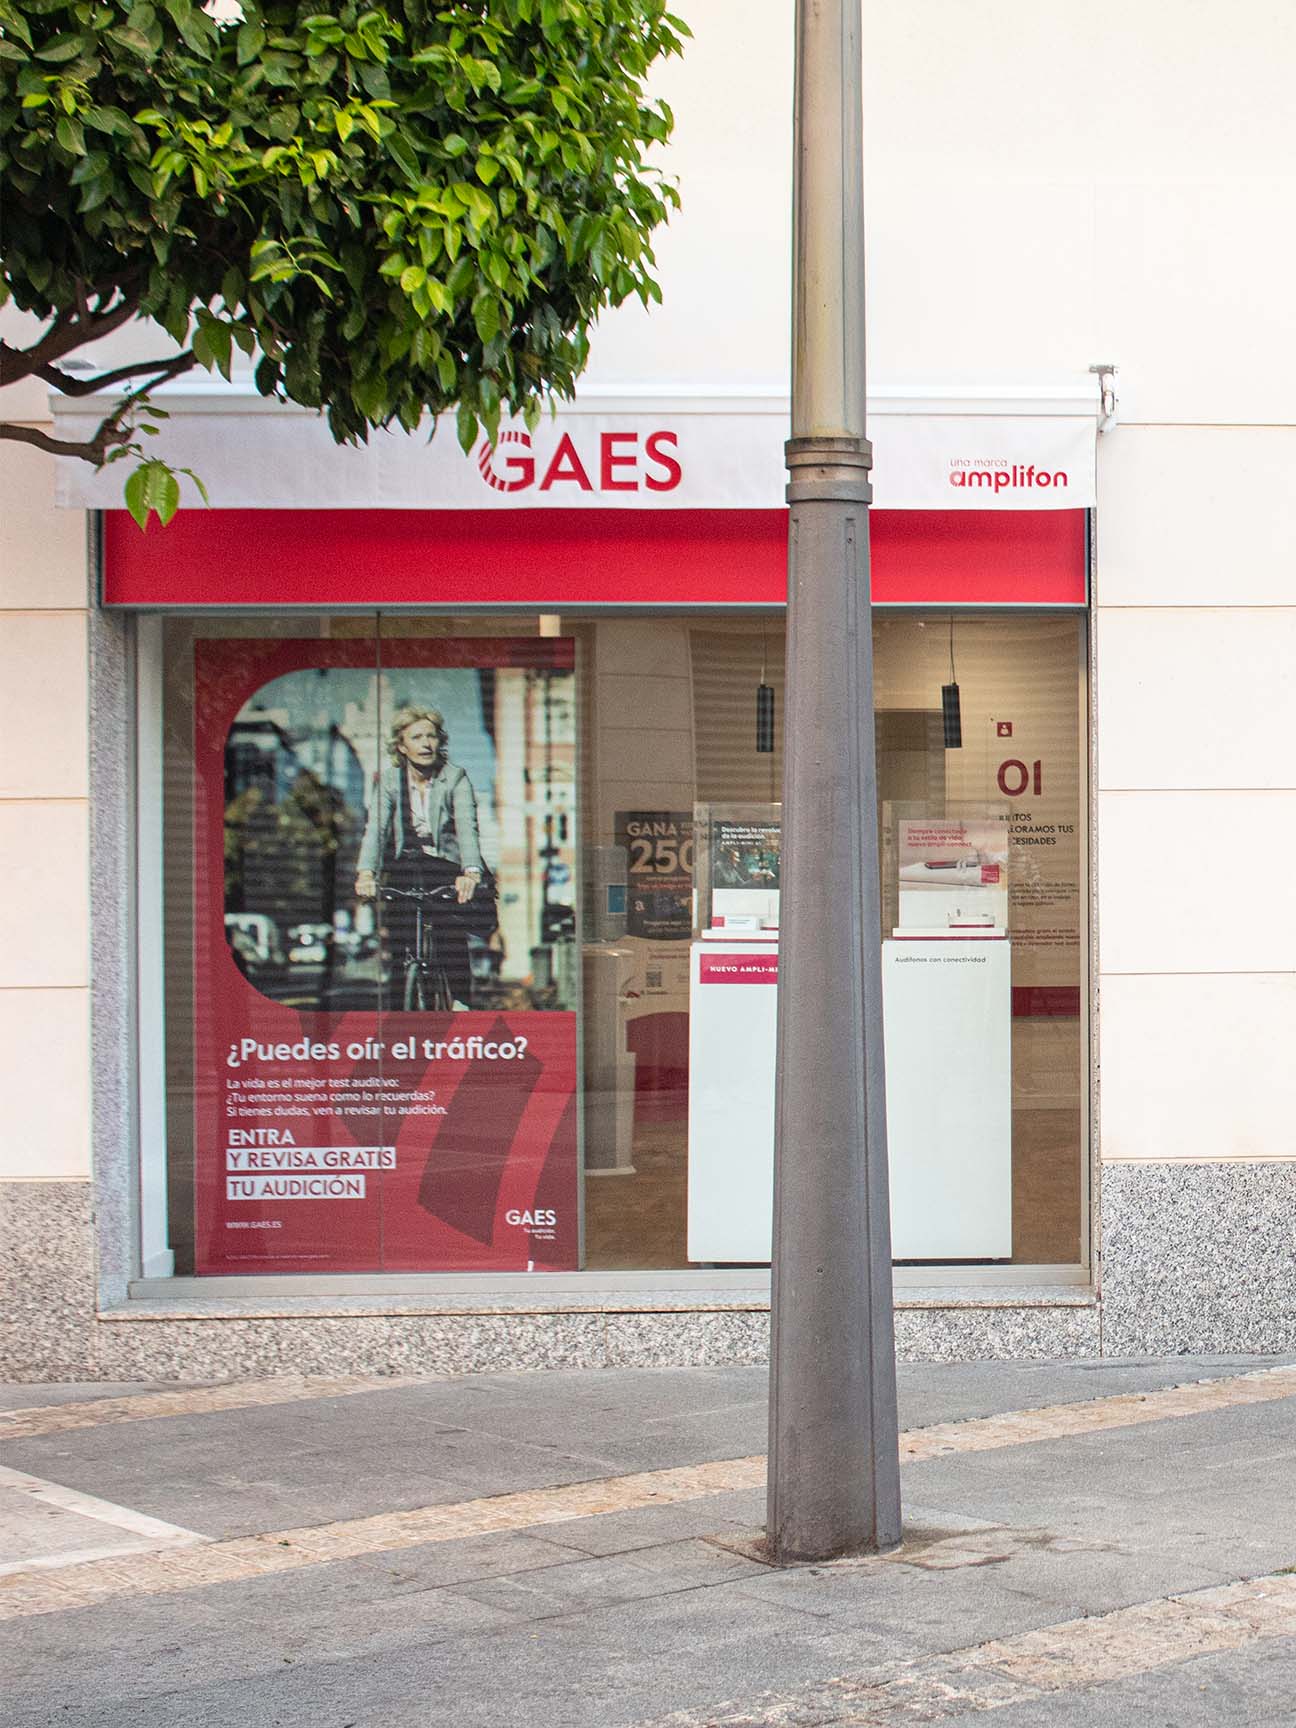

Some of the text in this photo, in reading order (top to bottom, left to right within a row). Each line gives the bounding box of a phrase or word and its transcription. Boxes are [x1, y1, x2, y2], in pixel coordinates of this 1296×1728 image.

[479, 431, 682, 492] GAES
[950, 458, 1008, 467] una marca
[949, 465, 1068, 494] amplifon
[627, 822, 677, 836] GANA
[1058, 825, 1074, 833] TUS
[226, 1036, 528, 1068] ¿Puedes oír el tráfico?
[226, 1079, 240, 1089] La
[241, 1078, 265, 1088] vida
[266, 1080, 280, 1088] es
[281, 1078, 292, 1088] el
[293, 1078, 326, 1091] mejor
[328, 1078, 350, 1088] test
[247, 1093, 292, 1102] entorno
[294, 1093, 328, 1101] suena
[329, 1093, 361, 1101] como
[362, 1091, 373, 1101] lo
[375, 1090, 436, 1101] recuerdas?
[226, 1106, 237, 1117] Si
[238, 1107, 273, 1117] tienes
[312, 1107, 333, 1115] ven
[334, 1107, 343, 1115] a
[344, 1106, 381, 1115] revisar
[383, 1105, 396, 1115] tu
[229, 1129, 296, 1145] ENTRA
[230, 1151, 393, 1168] Y REVISA GRATIS
[230, 1174, 360, 1196] TU AUDICIÓN
[505, 1209, 557, 1226] GAES
